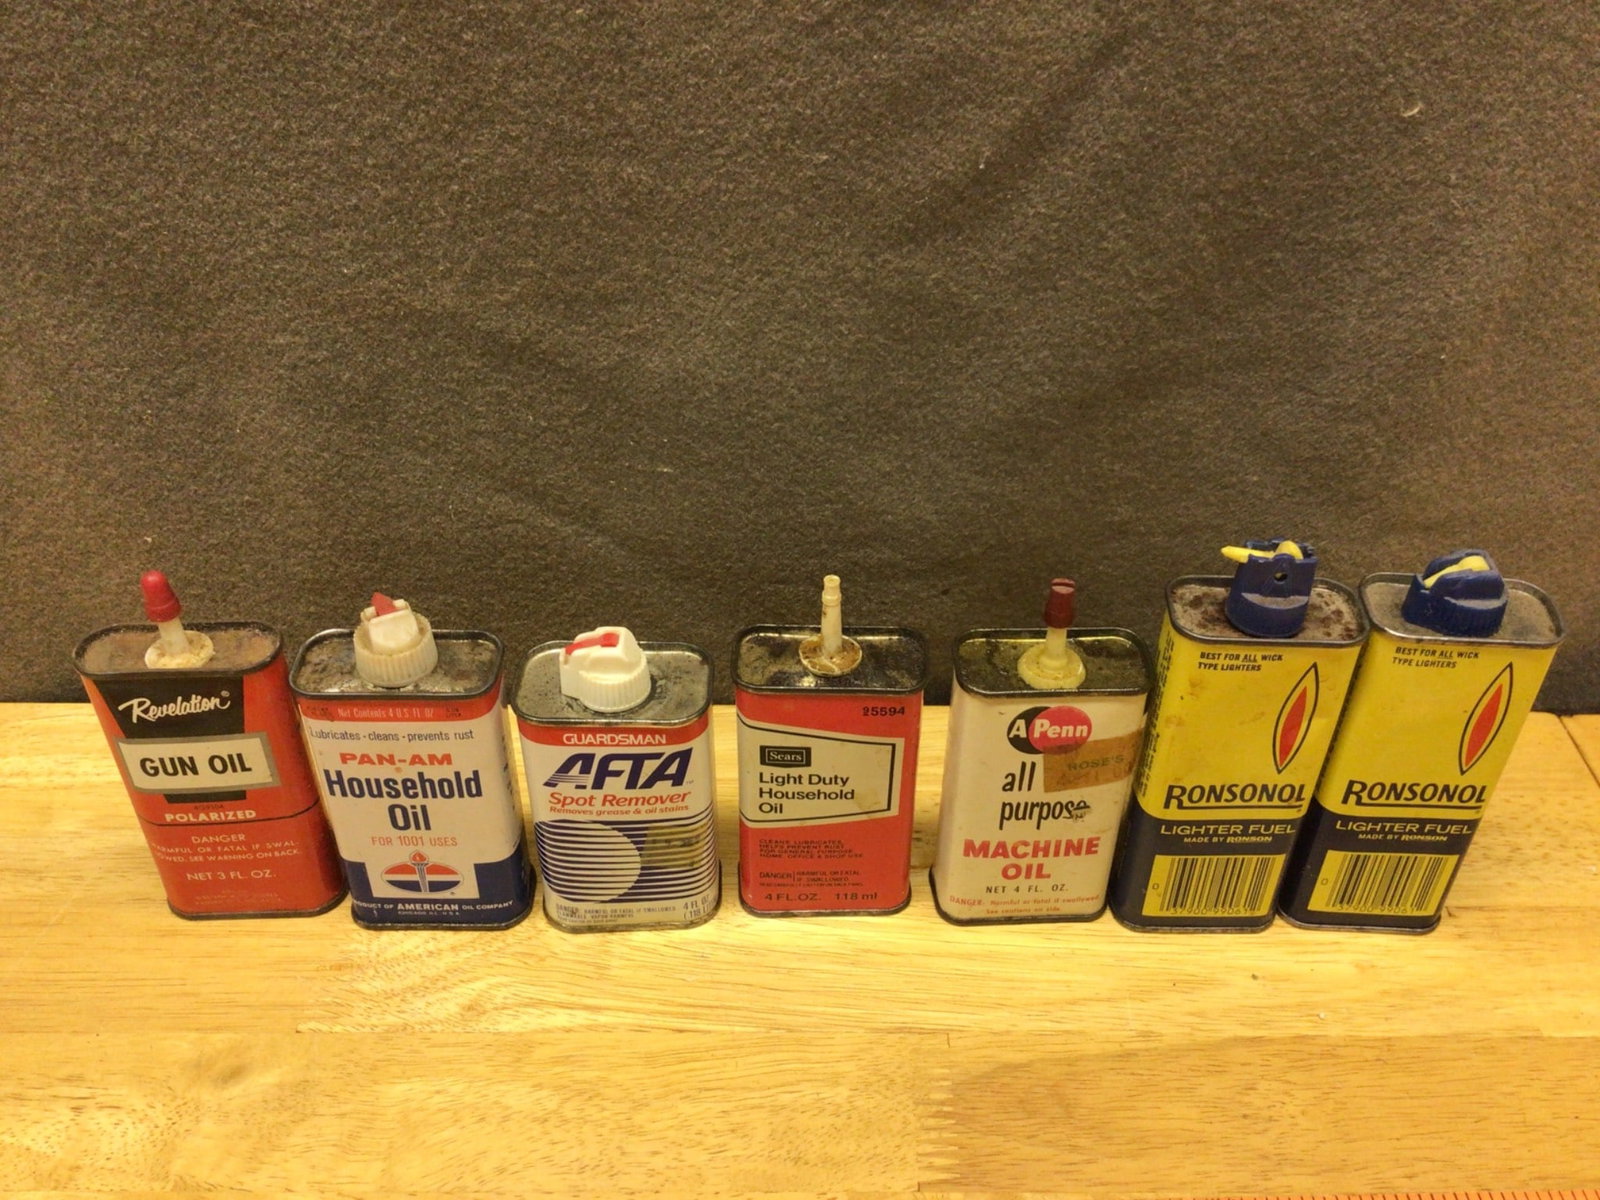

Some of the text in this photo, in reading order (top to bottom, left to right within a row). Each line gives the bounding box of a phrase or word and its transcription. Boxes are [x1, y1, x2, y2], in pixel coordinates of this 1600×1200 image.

[1200, 652, 1222, 660] BEST
[1241, 654, 1258, 662] ALL
[1395, 647, 1417, 655] BEST
[1438, 650, 1454, 659] ALL
[1457, 651, 1480, 659] WICK
[1198, 662, 1218, 670] TYPE
[1392, 657, 1457, 669] TYPE LIGHTERS
[118, 694, 231, 723] Revelation
[353, 708, 386, 718] Contents
[862, 706, 905, 716] 25594
[1009, 719, 1089, 738] A Penn
[309, 728, 474, 743] Lubricates cleans prevents rust
[562, 733, 667, 745] GUARDSMAN
[339, 753, 453, 766] PAN-AM
[769, 751, 802, 761] Sears
[139, 753, 252, 777] GUN OIL
[542, 747, 693, 790] AFTA
[759, 772, 849, 787] Light Duty
[1002, 761, 1037, 792] all
[323, 769, 483, 799] Household
[548, 791, 691, 809] Spot Remover
[759, 788, 855, 800] Household
[1163, 783, 1305, 810] RONSONOL
[1341, 779, 1487, 810] RONSONOL
[549, 806, 594, 815] Removes
[595, 807, 630, 816] grease
[632, 807, 642, 815] &
[645, 805, 658, 814] oil
[758, 802, 783, 814] Oil
[165, 810, 256, 822] POLARIZED
[387, 804, 431, 831] Oil
[1160, 823, 1296, 835] LIGHTER FUEL
[1335, 820, 1473, 834] LIGHTER FUEL
[191, 834, 246, 844] DANGER
[371, 835, 458, 847] FOR 1001 USES
[1226, 835, 1273, 844] RONSON
[1401, 834, 1448, 842] RONSON
[963, 836, 1101, 859] MACHINE
[186, 872, 213, 881] NET
[217, 872, 226, 880] 3
[1001, 863, 1051, 880] OIL
[986, 885, 1006, 894] NET
[1028, 884, 1043, 893] FL.
[1051, 884, 1069, 892] OZ.
[861, 892, 878, 900] ml
[397, 903, 459, 911] AMERICAN
[476, 901, 514, 910] COMPANY
